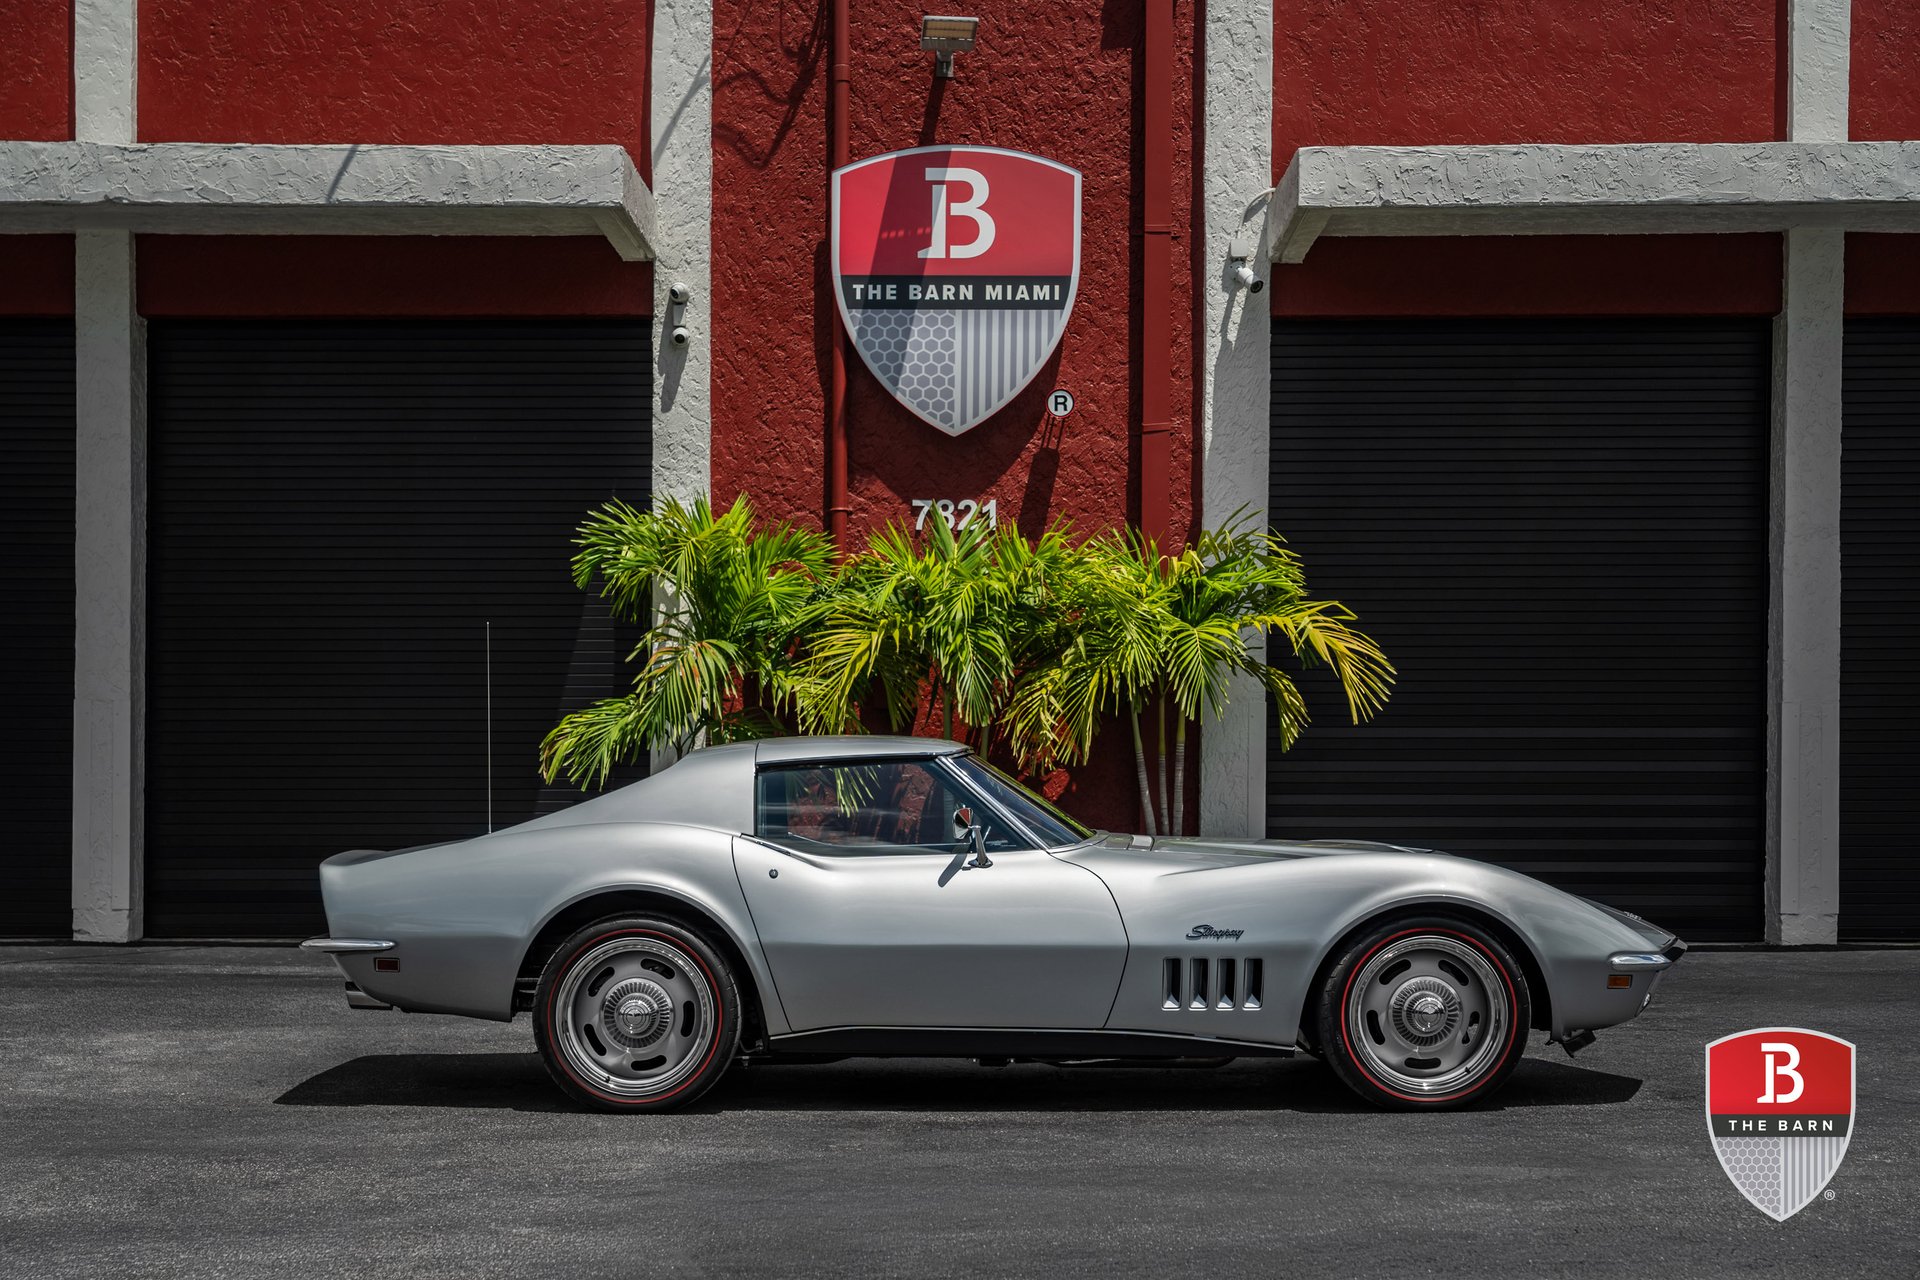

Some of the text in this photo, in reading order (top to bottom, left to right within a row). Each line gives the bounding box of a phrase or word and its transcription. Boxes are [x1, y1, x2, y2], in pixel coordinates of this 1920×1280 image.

[917, 167, 996, 259] B
[852, 284, 1060, 301] THE BARN MIAMI
[911, 499, 997, 531] 7821
[1185, 924, 1245, 942] Stingray
